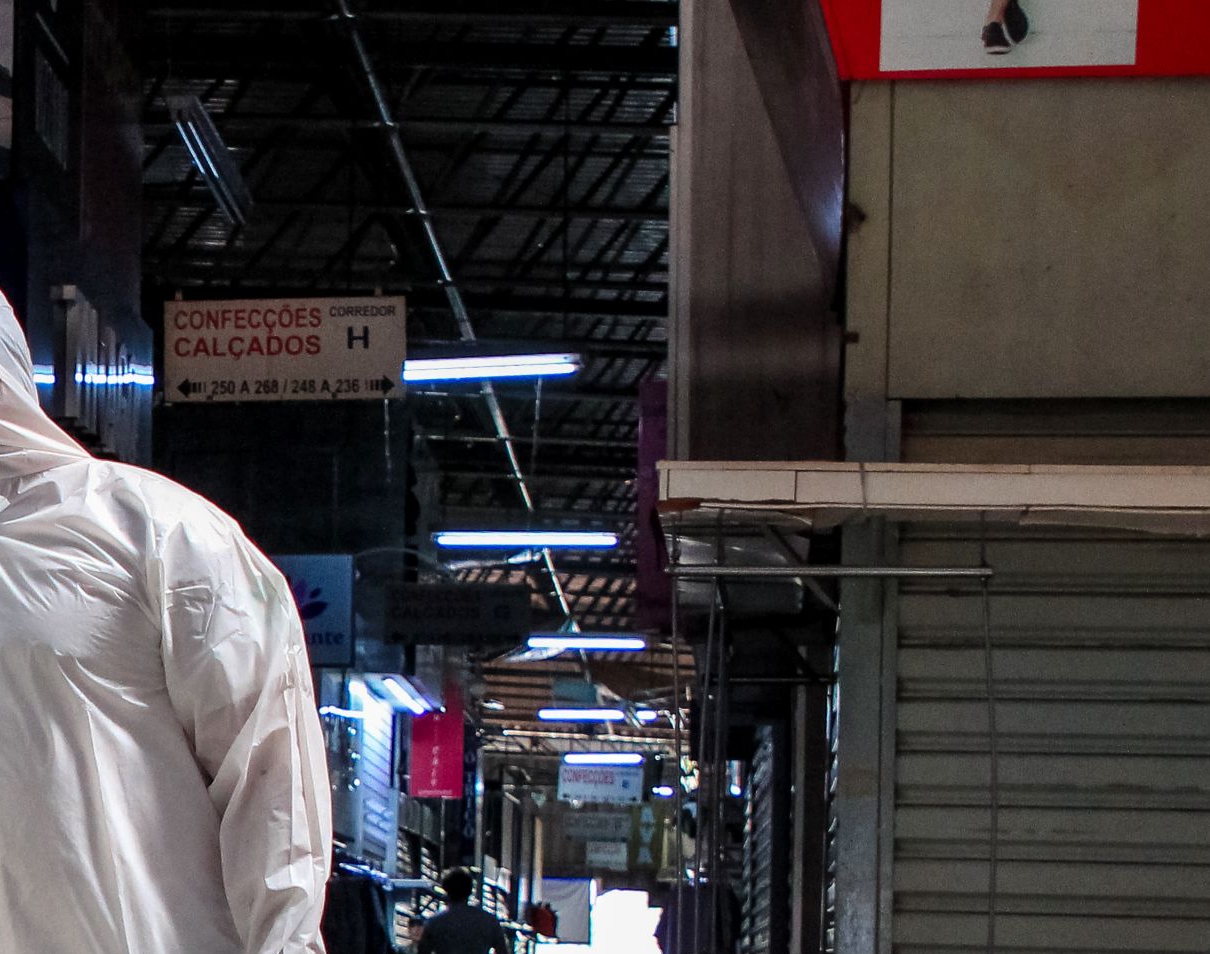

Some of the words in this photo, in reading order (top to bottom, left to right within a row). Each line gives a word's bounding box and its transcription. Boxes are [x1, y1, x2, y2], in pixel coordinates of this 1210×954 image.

[174, 305, 323, 335] CONFECÇÕES
[329, 305, 395, 317] CORREDOR
[174, 335, 322, 361] CALÇADOS
[346, 325, 370, 350] H
[212, 380, 236, 395] 250
[241, 380, 250, 394] A
[255, 379, 279, 394] 268
[320, 378, 331, 393] A
[335, 377, 360, 393] 236
